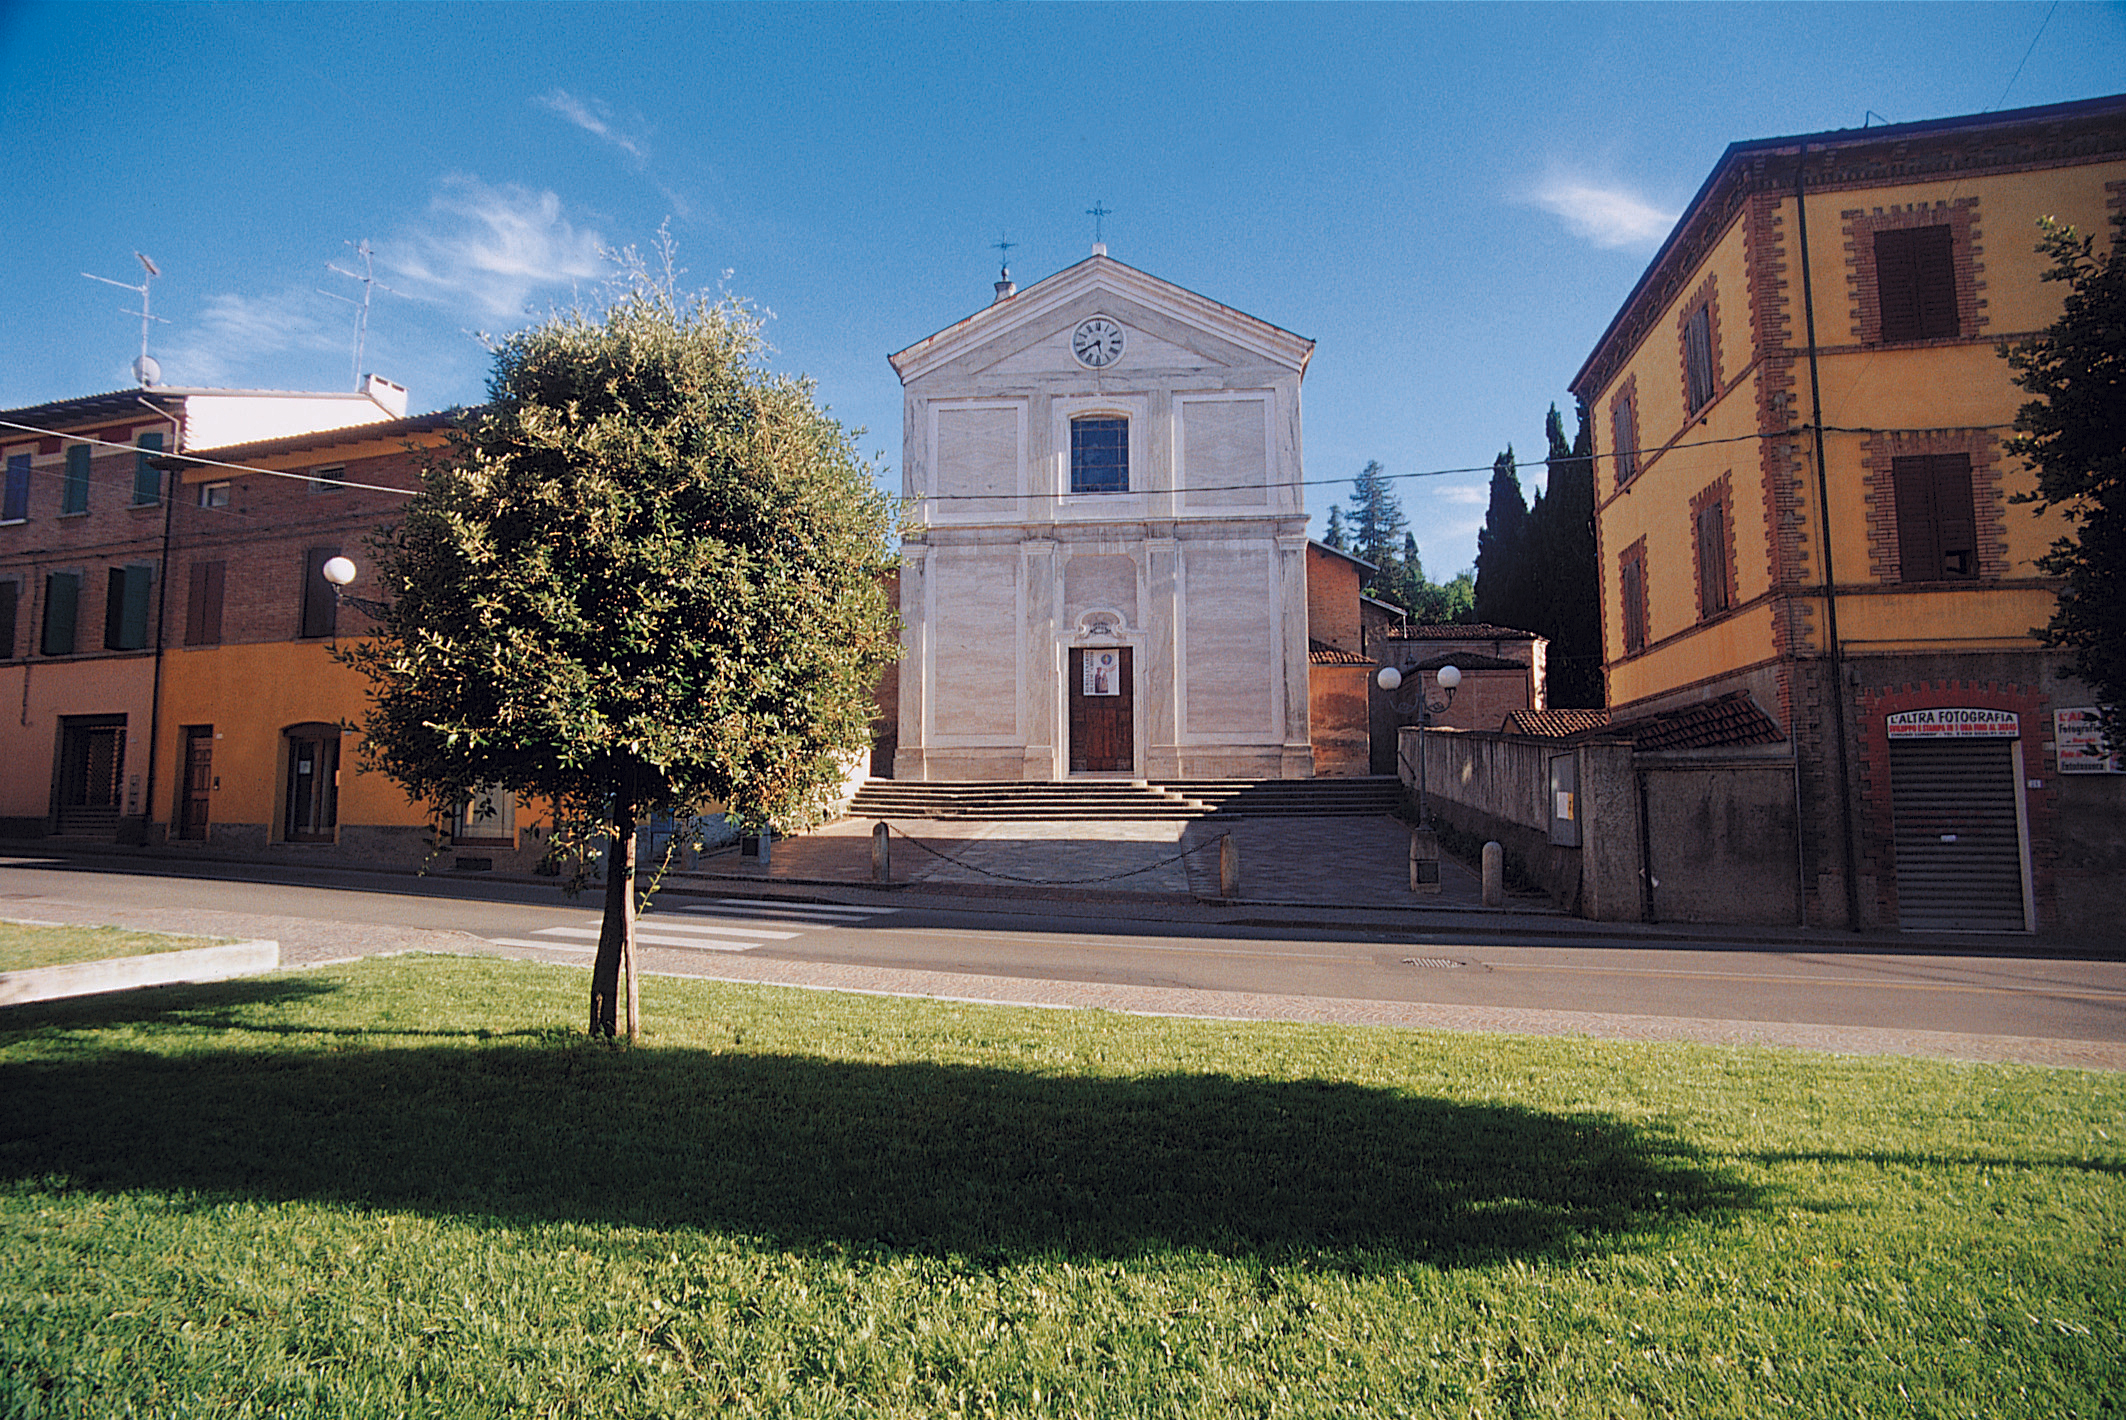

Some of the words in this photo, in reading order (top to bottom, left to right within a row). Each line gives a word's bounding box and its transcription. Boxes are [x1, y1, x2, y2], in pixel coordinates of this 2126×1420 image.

[1890, 712, 1935, 724] L'ALTRA
[1939, 711, 2014, 723] FOTOGRAFIA
[1923, 724, 1946, 732] STAMPA
